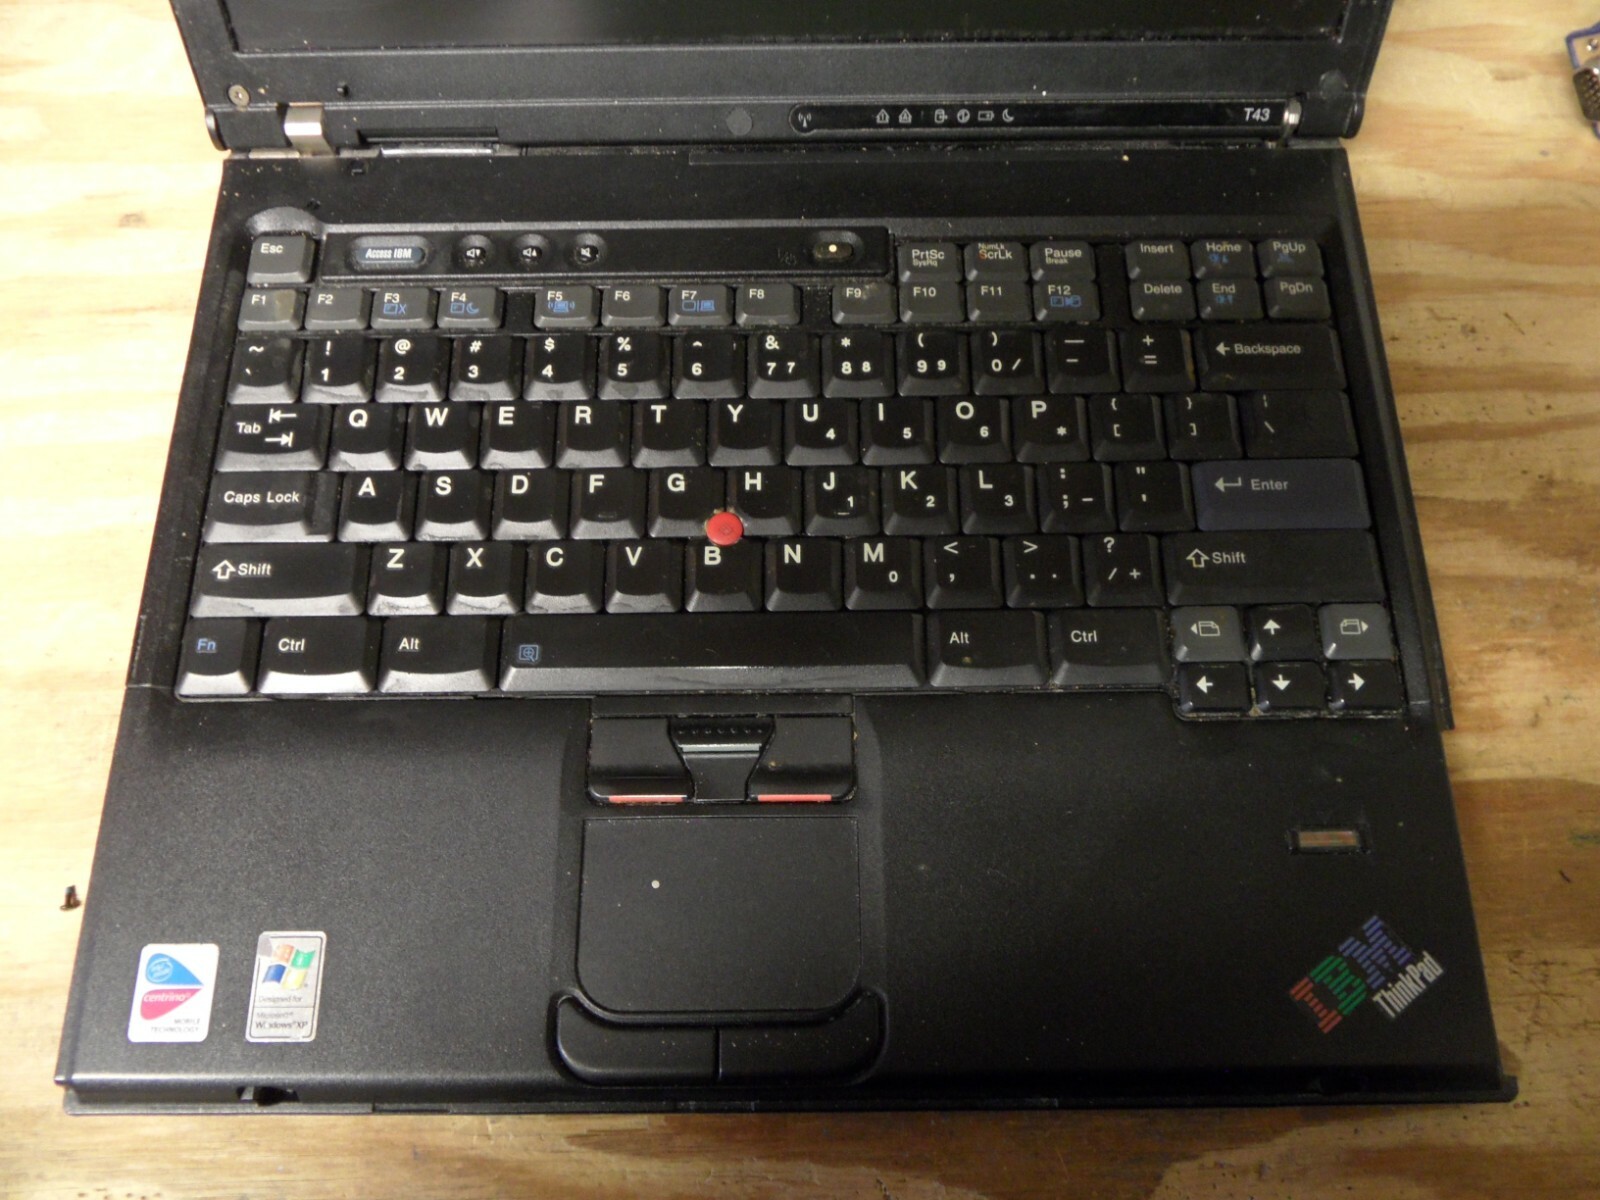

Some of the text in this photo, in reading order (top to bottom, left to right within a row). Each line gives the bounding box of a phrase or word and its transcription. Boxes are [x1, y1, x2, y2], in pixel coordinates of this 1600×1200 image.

[1245, 108, 1270, 121] T43
[261, 243, 283, 253] Esc
[1044, 248, 1082, 258] Pause
[1141, 244, 1173, 253] Insert
[1206, 242, 1241, 252] Home
[1273, 242, 1305, 253] PgUp
[365, 248, 413, 259] Access IBM
[911, 250, 945, 260] PrtSc
[978, 250, 1013, 260] ScrLk
[750, 289, 764, 299] F8
[847, 288, 861, 297] F9
[914, 287, 936, 297] F10
[981, 286, 1001, 295] F11
[1048, 285, 1070, 294] F12
[1144, 284, 1181, 294] Delete
[1212, 283, 1235, 293] End
[1280, 282, 1312, 294] PgDn
[252, 295, 266, 304] F1
[318, 294, 333, 304] F2
[384, 293, 400, 304] F3
[451, 292, 467, 303] F4
[547, 291, 563, 301] F5
[615, 291, 630, 301] F6
[682, 290, 698, 301] F7
[545, 338, 554, 352] $
[618, 337, 631, 351] %
[766, 335, 779, 349] &
[918, 333, 923, 347] (
[992, 332, 997, 346] )
[1143, 336, 1154, 345] +
[326, 341, 331, 355] !
[395, 339, 411, 354] @
[470, 341, 481, 352] #
[1234, 344, 1300, 355] Backspace
[992, 359, 1021, 371] 0 /
[1144, 355, 1157, 364] =
[468, 365, 478, 378] 3
[542, 365, 553, 377] 4
[618, 364, 627, 376] 5
[692, 363, 702, 375] 6
[767, 362, 795, 375] 7 7
[842, 361, 871, 374] 8 8
[917, 360, 946, 372] 9 9
[322, 368, 329, 381] 1
[394, 367, 404, 380] 2
[499, 407, 514, 424] E
[575, 406, 591, 423] R
[651, 405, 666, 423] T
[728, 405, 743, 422] Y
[803, 404, 818, 421] U
[878, 403, 884, 421] I
[956, 402, 974, 419] O
[1032, 401, 1046, 418] P
[349, 409, 367, 427] Q
[425, 408, 448, 426] W
[237, 422, 261, 433] Tab
[980, 426, 988, 437] 6
[1114, 424, 1120, 437] [
[1190, 423, 1196, 435] ]
[1265, 422, 1274, 432] \
[826, 428, 835, 439] 4
[903, 428, 911, 439] 5
[512, 475, 528, 494] D
[590, 475, 604, 493] F
[668, 473, 685, 491] G
[745, 472, 761, 490] H
[823, 472, 835, 490] J
[901, 471, 917, 489] K
[979, 470, 993, 488] L
[1251, 479, 1287, 490] Enter
[358, 477, 375, 496] A
[436, 477, 451, 495] S
[224, 491, 299, 505] Caps Lock
[848, 496, 853, 507] 1
[927, 496, 934, 507] 2
[1005, 495, 1013, 506] 3
[944, 542, 958, 554] <
[1023, 541, 1037, 553] >
[1104, 537, 1114, 552] ?
[387, 549, 404, 568] Z
[467, 548, 483, 567] X
[546, 548, 563, 566] C
[626, 547, 642, 566] V
[704, 546, 722, 566] B
[784, 544, 800, 563] N
[864, 543, 883, 562] M
[1213, 552, 1245, 563] Shift
[237, 563, 271, 576] Shift
[1109, 568, 1140, 580] / +
[889, 571, 898, 582] 0
[950, 632, 969, 643] Alt
[1071, 631, 1097, 642] Ctrl
[198, 639, 215, 650] Fn
[279, 638, 304, 651] Ctrl
[399, 638, 419, 649] Alt
[1290, 915, 1413, 1033] IBM
[1372, 950, 1444, 1018] ThinkPad
